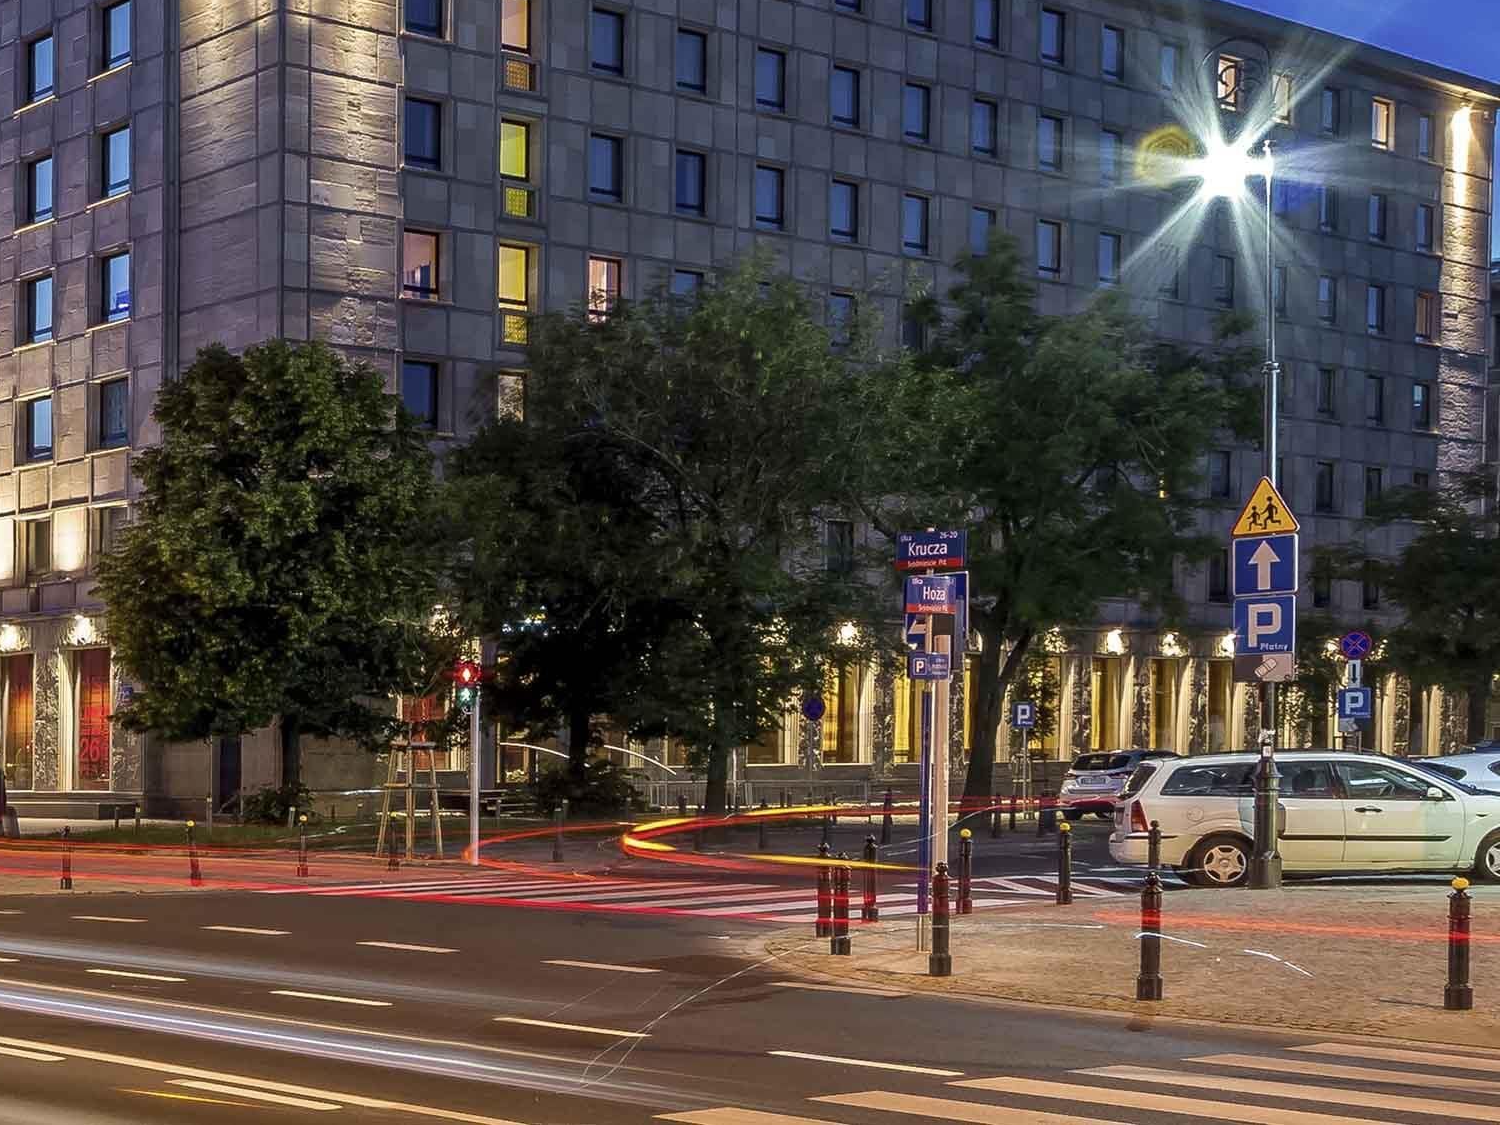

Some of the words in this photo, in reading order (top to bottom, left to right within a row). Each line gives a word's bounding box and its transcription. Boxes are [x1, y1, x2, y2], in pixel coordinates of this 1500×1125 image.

[908, 542, 948, 556] Krucza
[1248, 603, 1282, 647] P
[916, 660, 925, 673] P
[1345, 691, 1364, 715] P
[1017, 705, 1030, 725] P
